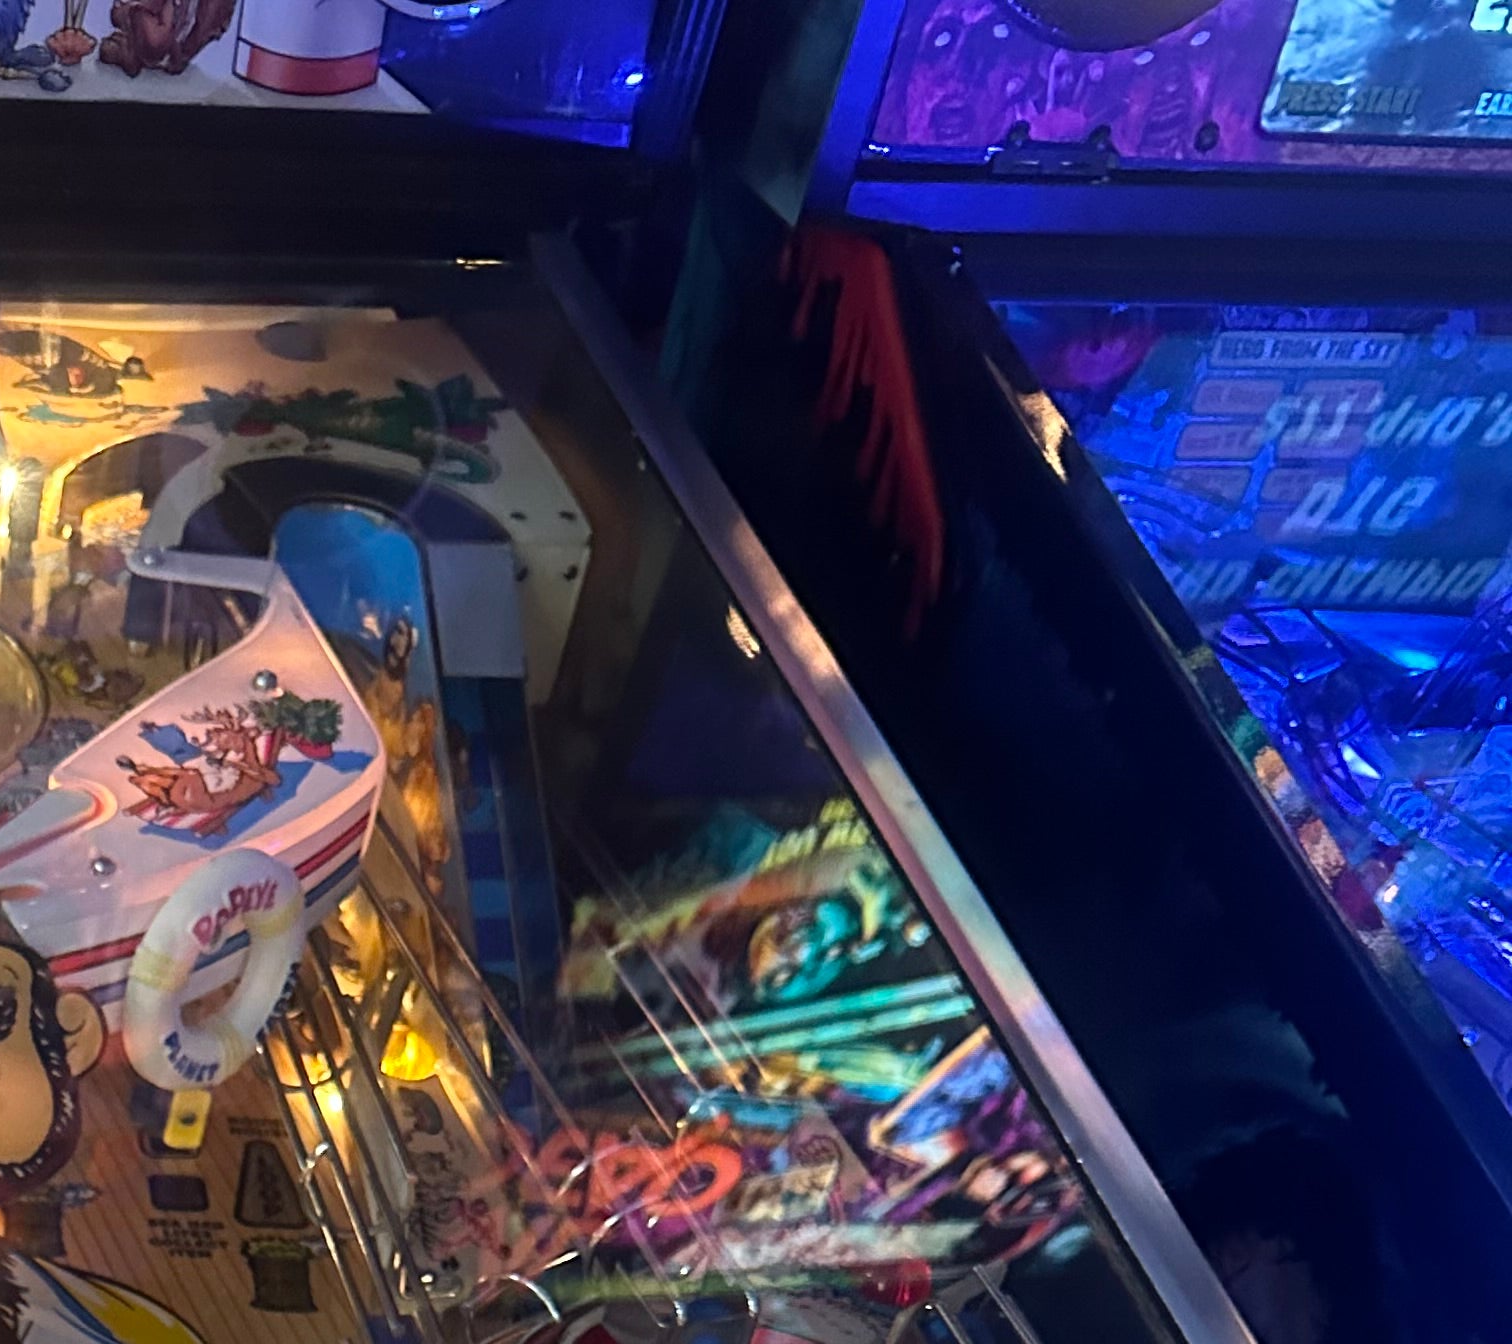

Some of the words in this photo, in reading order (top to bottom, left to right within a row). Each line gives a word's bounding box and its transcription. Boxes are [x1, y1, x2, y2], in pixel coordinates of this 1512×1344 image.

[1282, 81, 1349, 115] PRESS
[192, 877, 279, 947] POPEYE
[163, 1031, 220, 1083] PLANET
